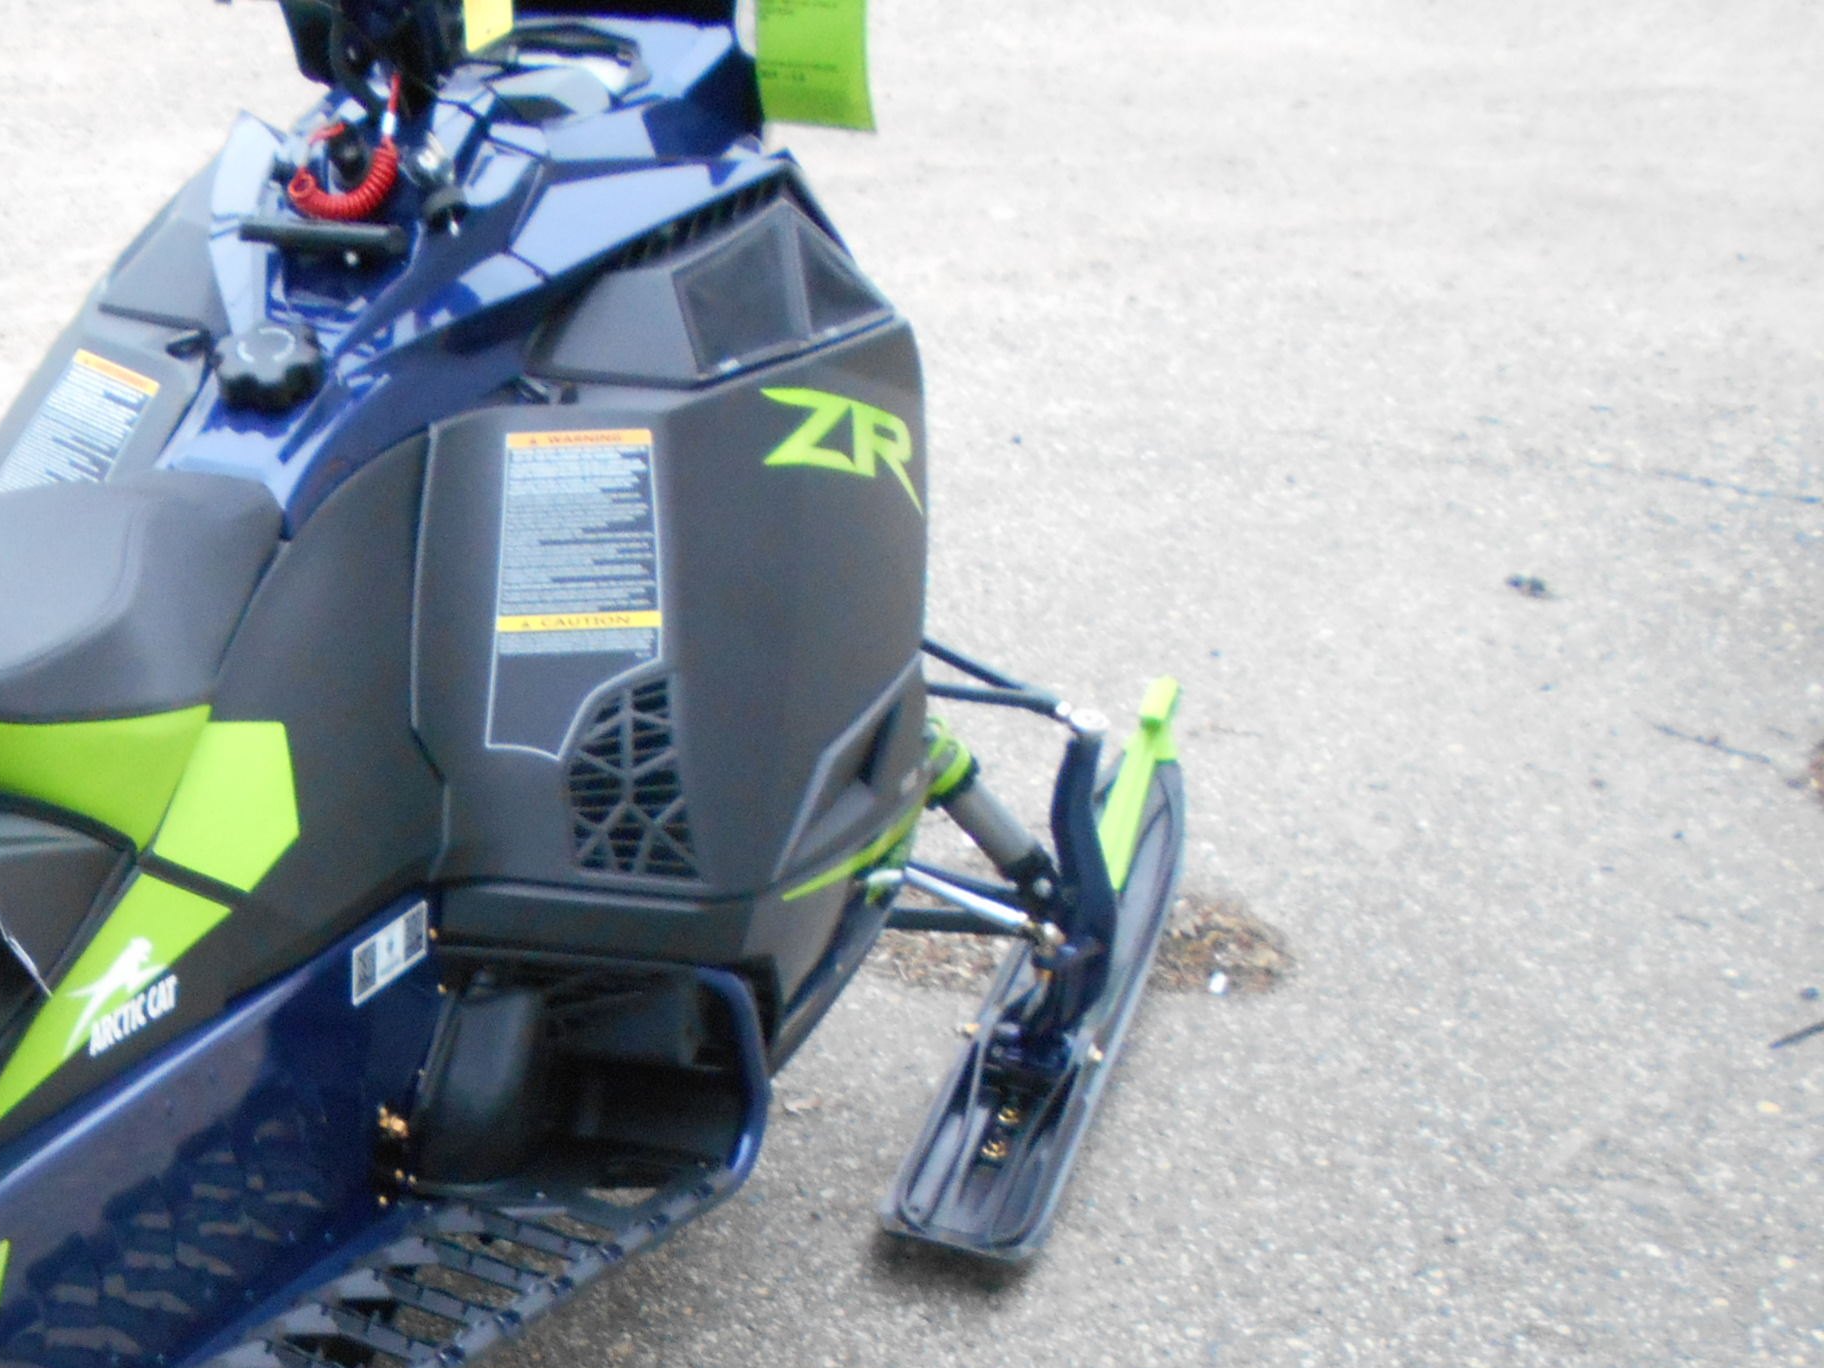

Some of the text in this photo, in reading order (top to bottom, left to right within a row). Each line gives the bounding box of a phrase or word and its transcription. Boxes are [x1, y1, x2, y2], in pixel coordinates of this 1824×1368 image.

[549, 433, 623, 444] WARNING
[760, 387, 924, 515] ZR
[541, 614, 631, 627] CAUTION
[89, 974, 178, 1057] ARCTIC CAT
